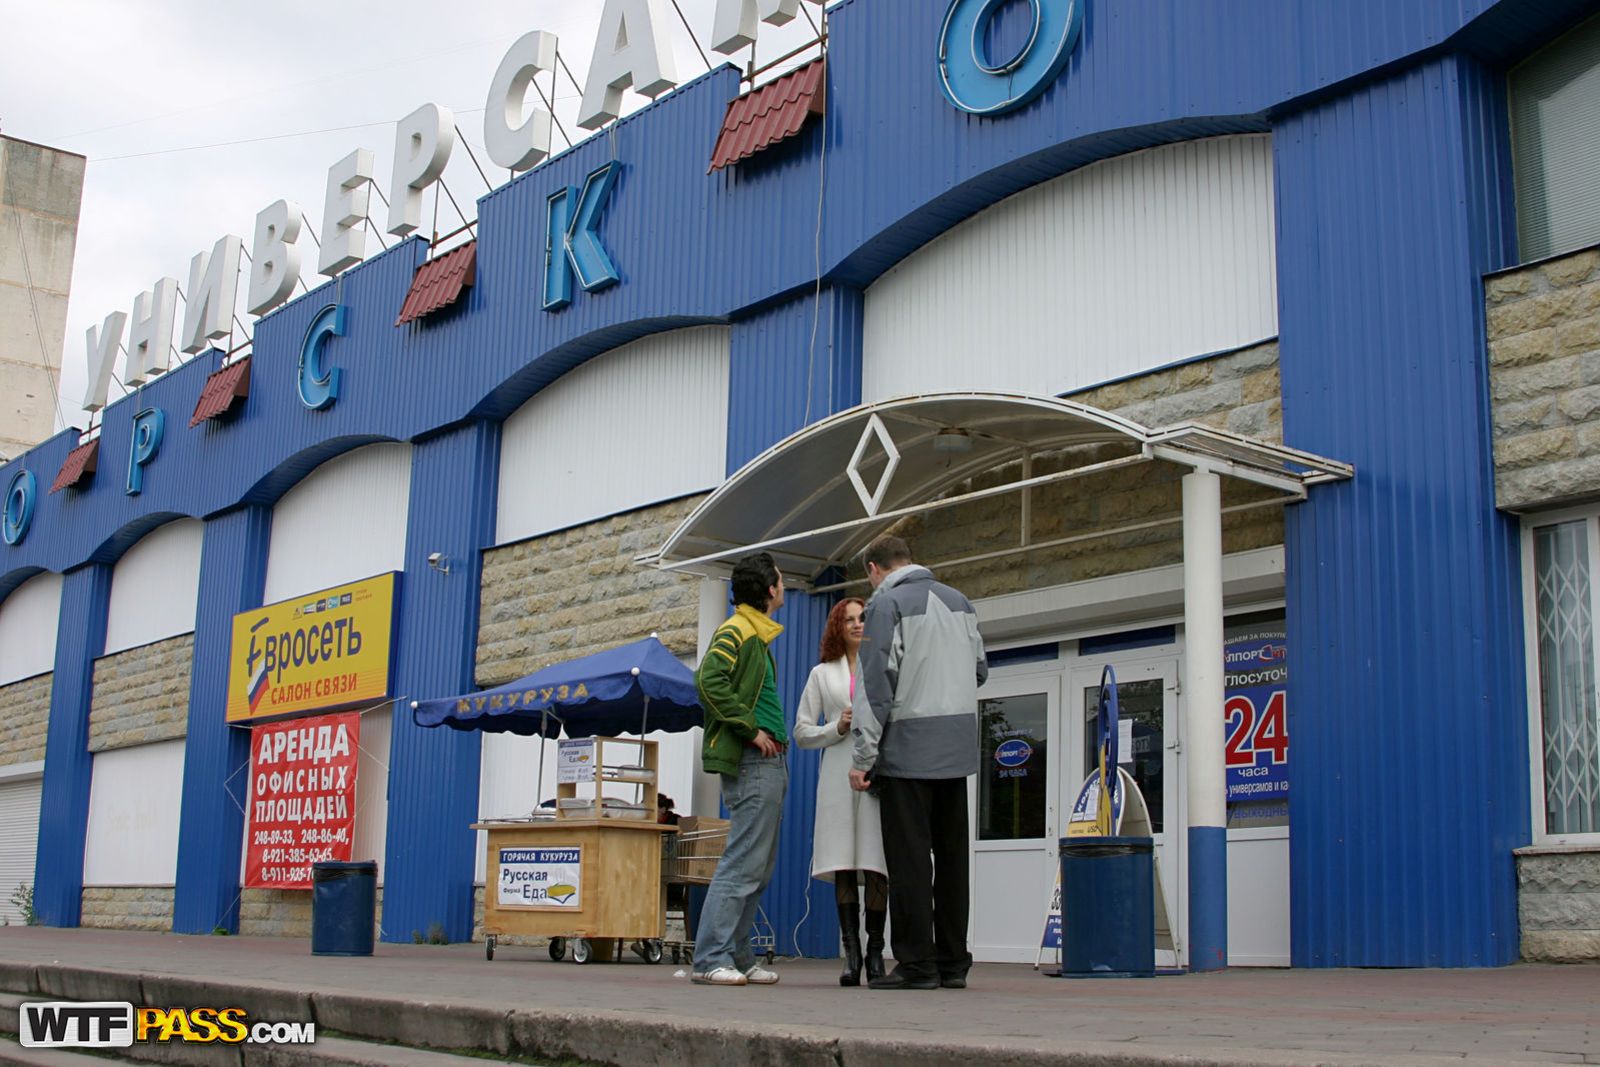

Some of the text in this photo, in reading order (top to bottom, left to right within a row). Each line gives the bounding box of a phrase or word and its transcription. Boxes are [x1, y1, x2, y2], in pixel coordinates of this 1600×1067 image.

[82, 0, 826, 413] УНИВЕРСА
[247, 617, 362, 684] Евросеть
[271, 673, 358, 705] САЛОН СВЯЗИ
[457, 683, 589, 713] КУКУРУЗА
[1224, 690, 1288, 768] 24
[258, 724, 349, 765] АРЕНДА
[257, 766, 348, 796] ОФИСНЫХ
[1238, 766, 1269, 778] часа
[1229, 781, 1273, 797] универсамов
[256, 790, 347, 825] ПЛОЩАДЕЙ
[503, 852, 578, 862] ГОРЯЧАЯ КУКУРУЗА
[503, 868, 548, 884] Русская
[523, 884, 548, 902] Еда
